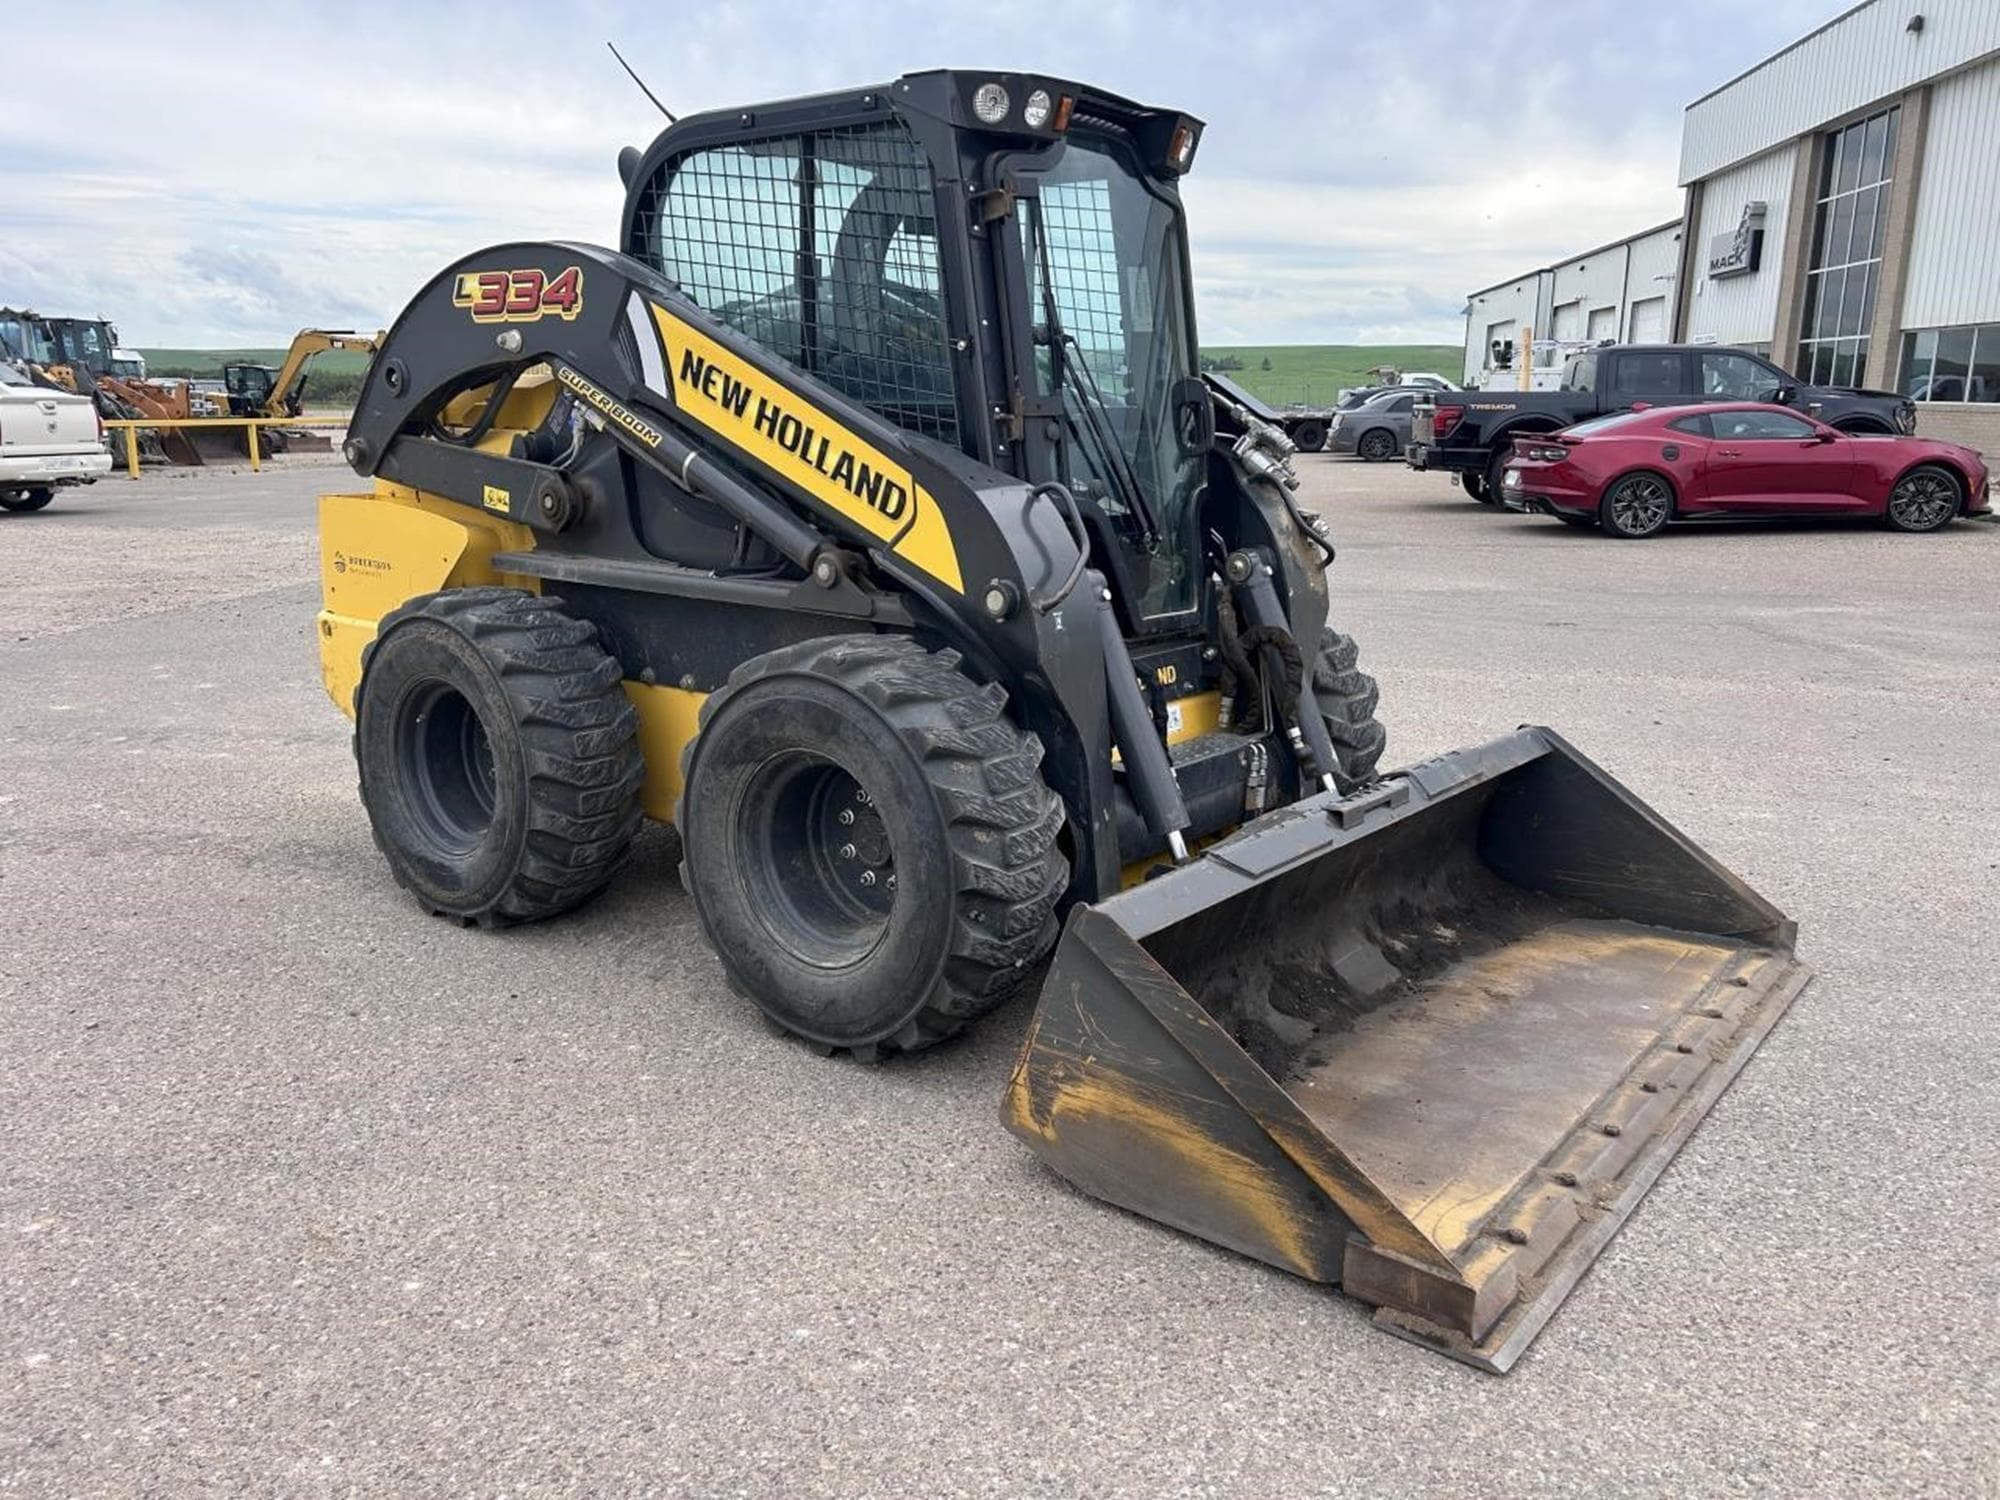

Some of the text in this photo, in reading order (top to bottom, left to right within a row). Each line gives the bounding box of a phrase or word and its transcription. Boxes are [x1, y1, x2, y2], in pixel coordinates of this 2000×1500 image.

[1710, 254, 1742, 270] MACK
[454, 267, 582, 322] L334
[680, 348, 907, 521] NEW HOLLAND
